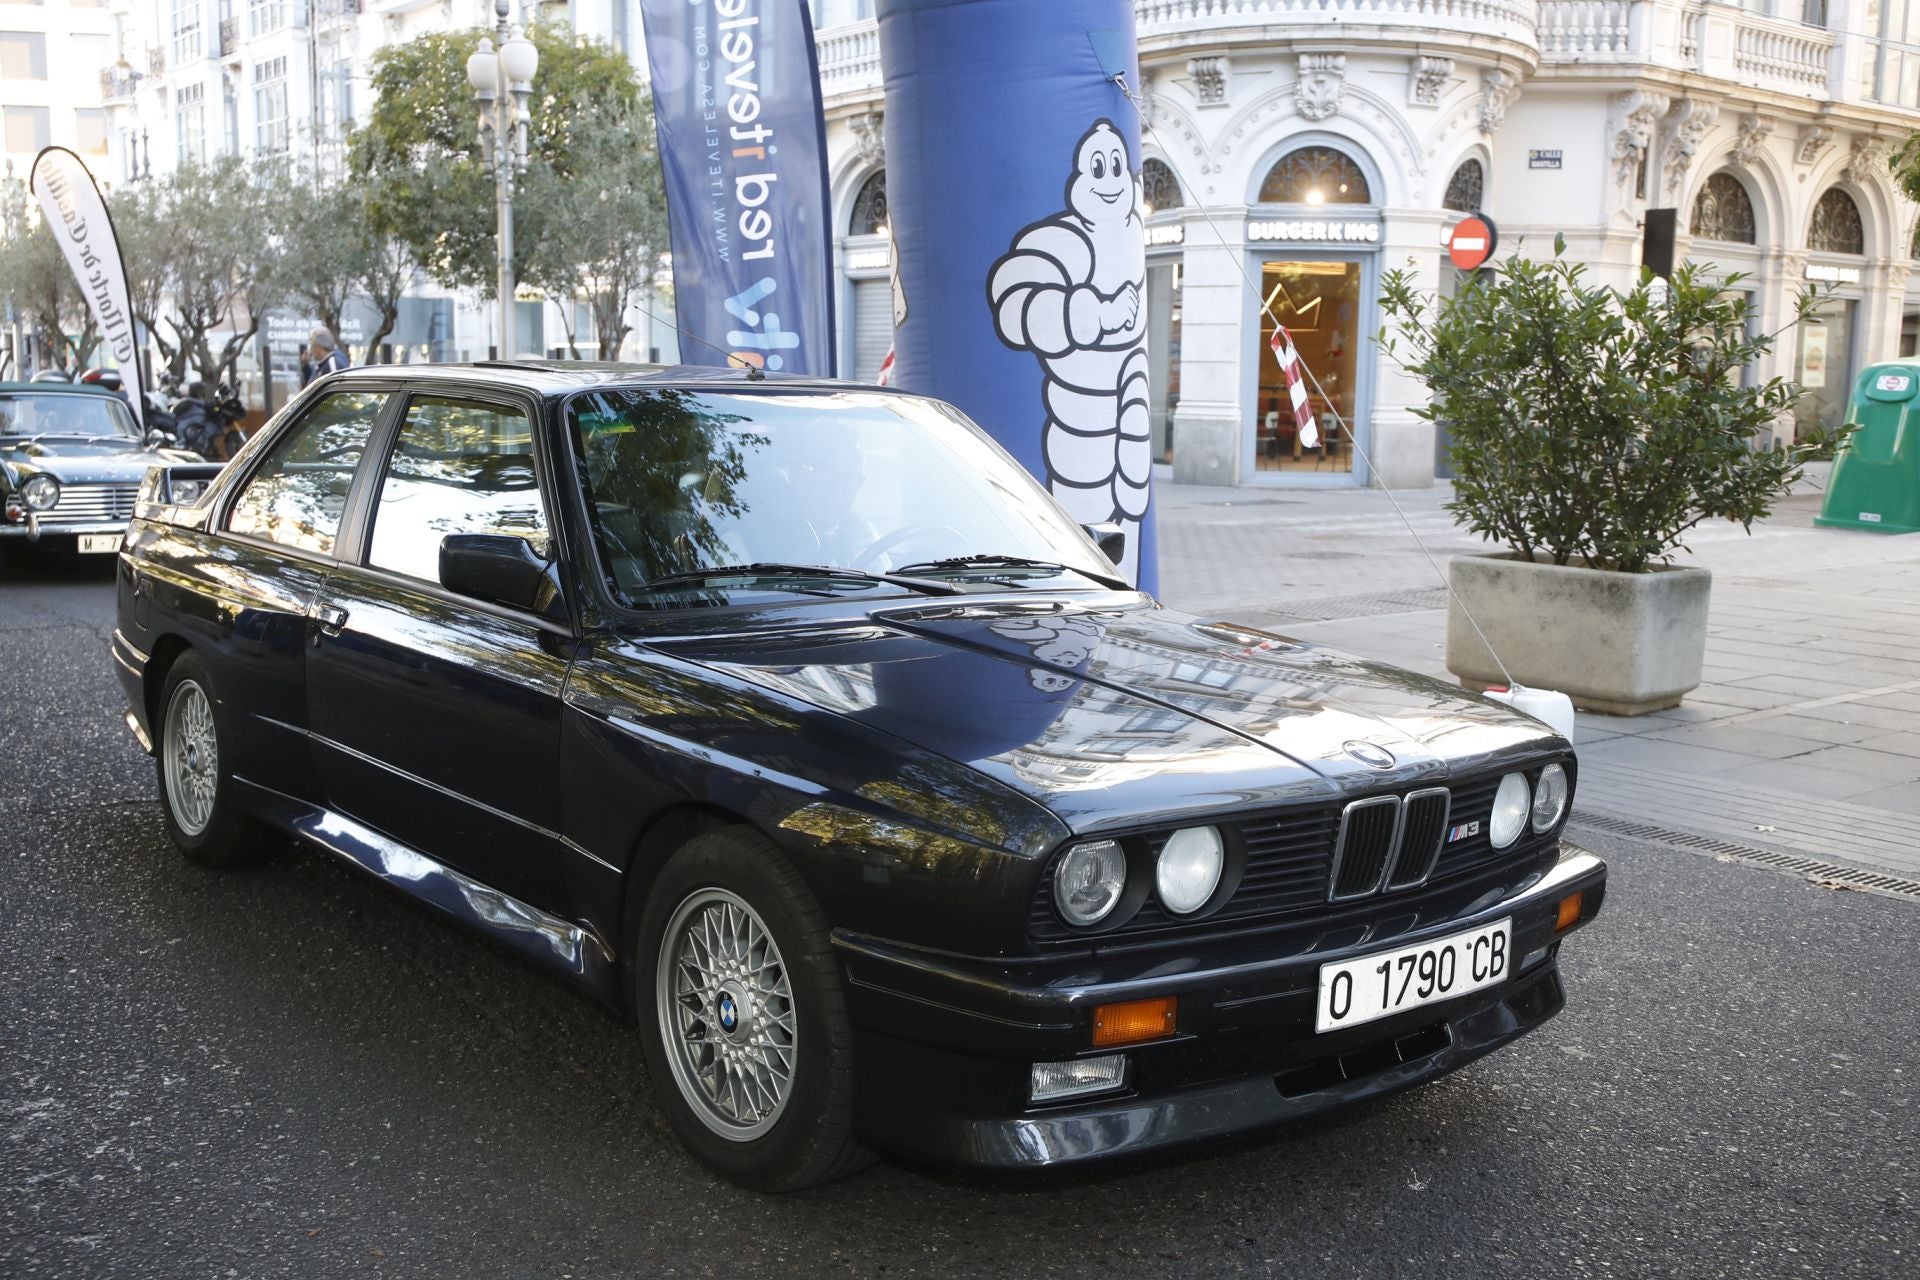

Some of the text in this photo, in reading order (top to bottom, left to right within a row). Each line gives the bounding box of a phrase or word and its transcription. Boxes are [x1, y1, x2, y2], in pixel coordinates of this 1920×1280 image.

[1248, 222, 1379, 242] BURGER KING
[1380, 945, 1456, 1010] 1790
[1472, 929, 1506, 982] CB
